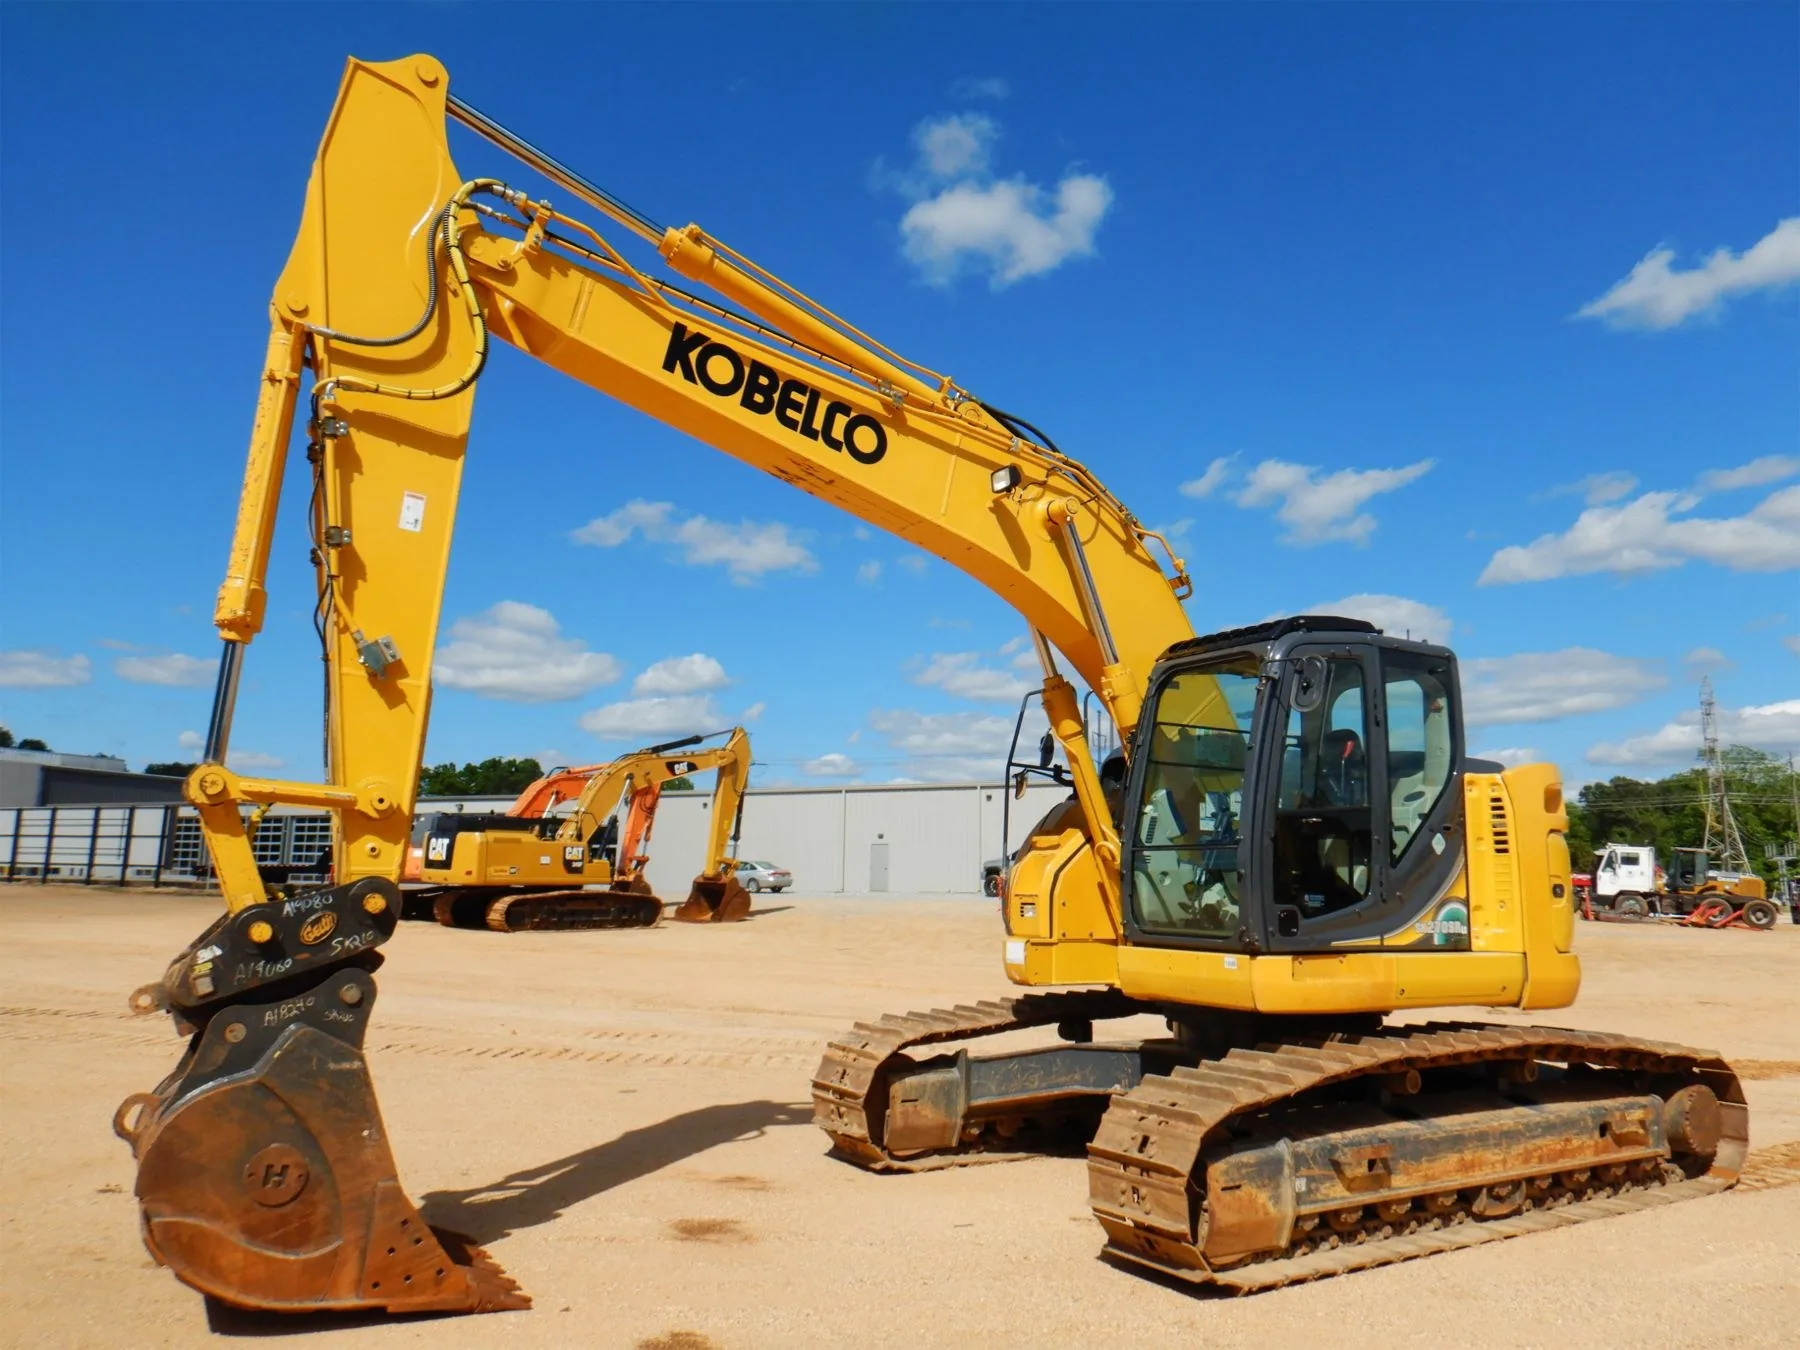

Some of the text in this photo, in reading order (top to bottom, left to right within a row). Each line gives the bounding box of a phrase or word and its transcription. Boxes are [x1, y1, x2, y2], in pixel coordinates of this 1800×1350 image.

[662, 320, 888, 465] KOBELCO
[674, 761, 688, 775] CAT
[428, 837, 450, 861] CAT
[565, 846, 584, 860] CAT
[262, 1164, 290, 1189] H
